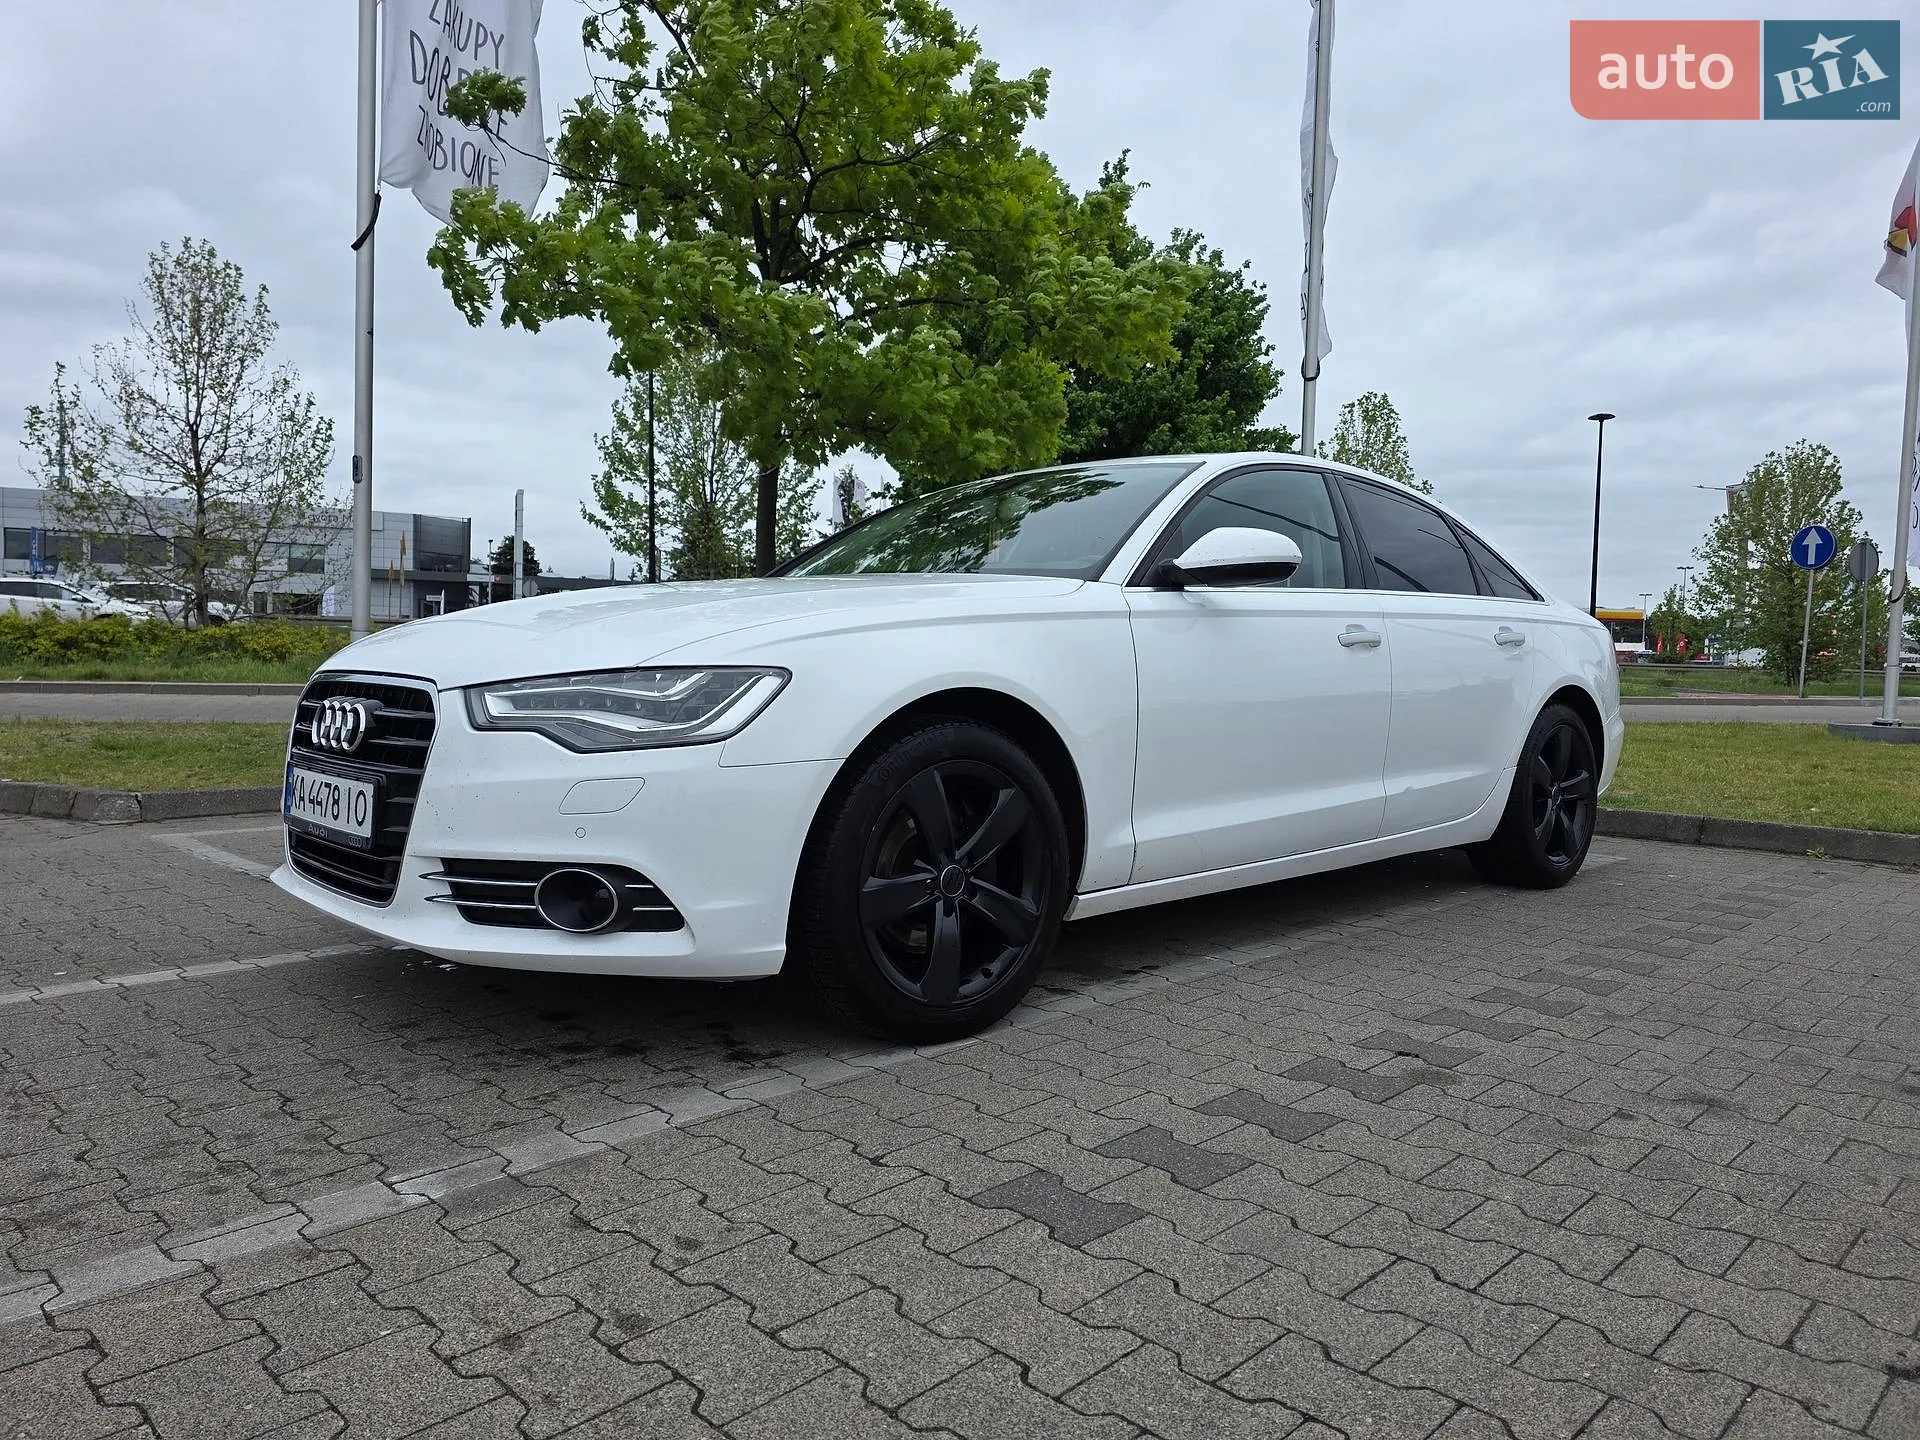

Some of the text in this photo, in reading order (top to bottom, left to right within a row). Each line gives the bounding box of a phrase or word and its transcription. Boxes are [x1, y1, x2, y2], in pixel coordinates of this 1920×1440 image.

[429, 0, 504, 69] ZAKUPY
[291, 773, 367, 828] KA 4478 IO
